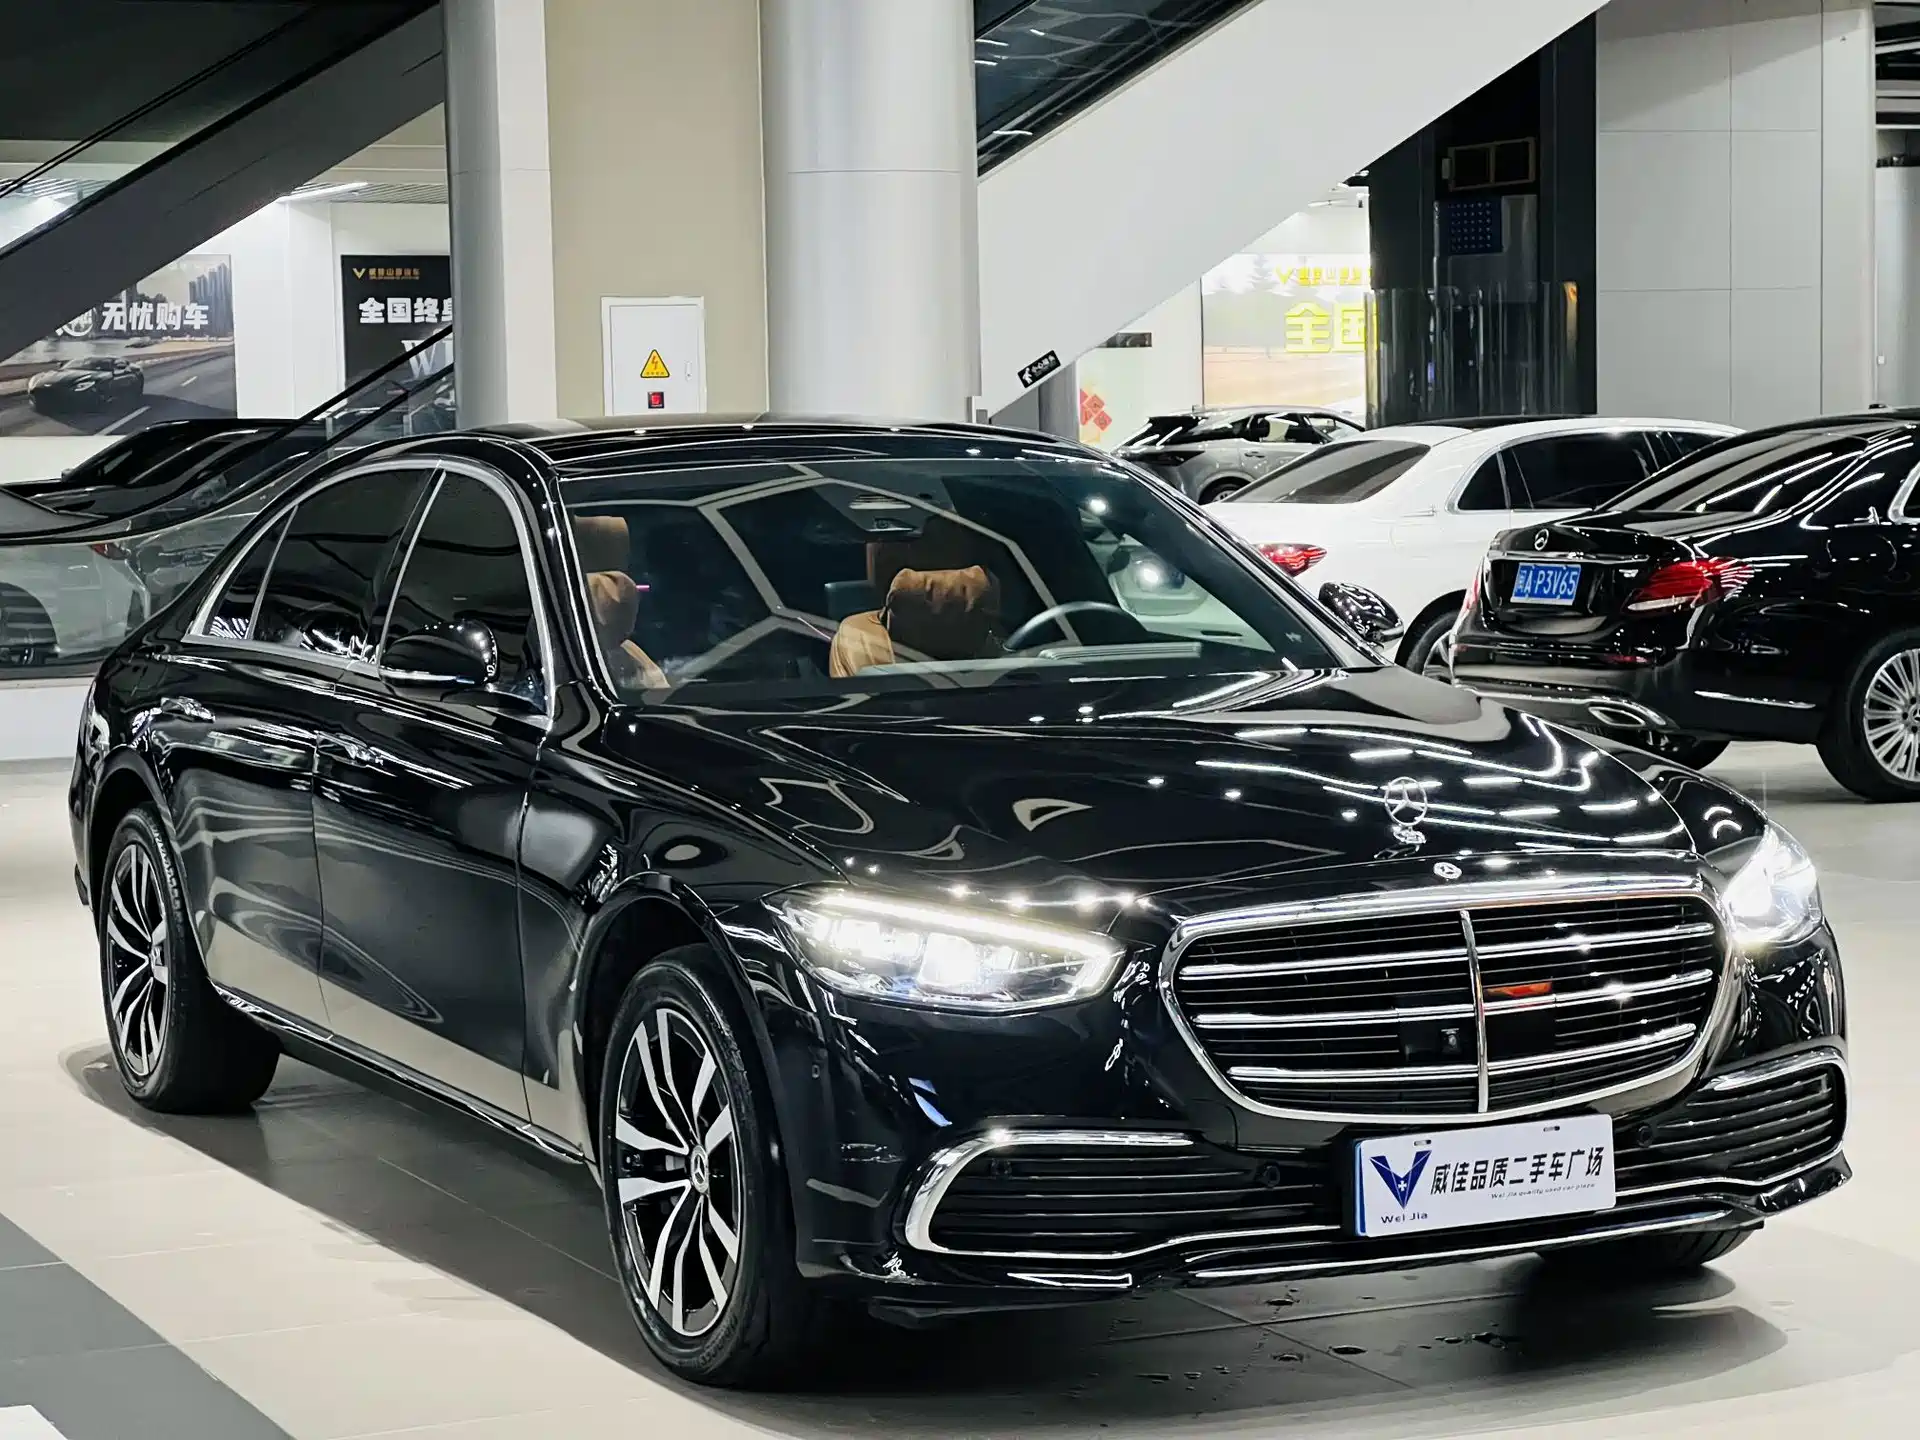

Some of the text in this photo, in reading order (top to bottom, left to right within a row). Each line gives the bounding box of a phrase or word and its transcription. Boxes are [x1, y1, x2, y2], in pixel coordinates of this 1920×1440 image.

[101, 302, 209, 332] 无忧购车
[1430, 1147, 1604, 1195] 威佳品质二手车广场
[1381, 1211, 1428, 1224] Wei Jia
